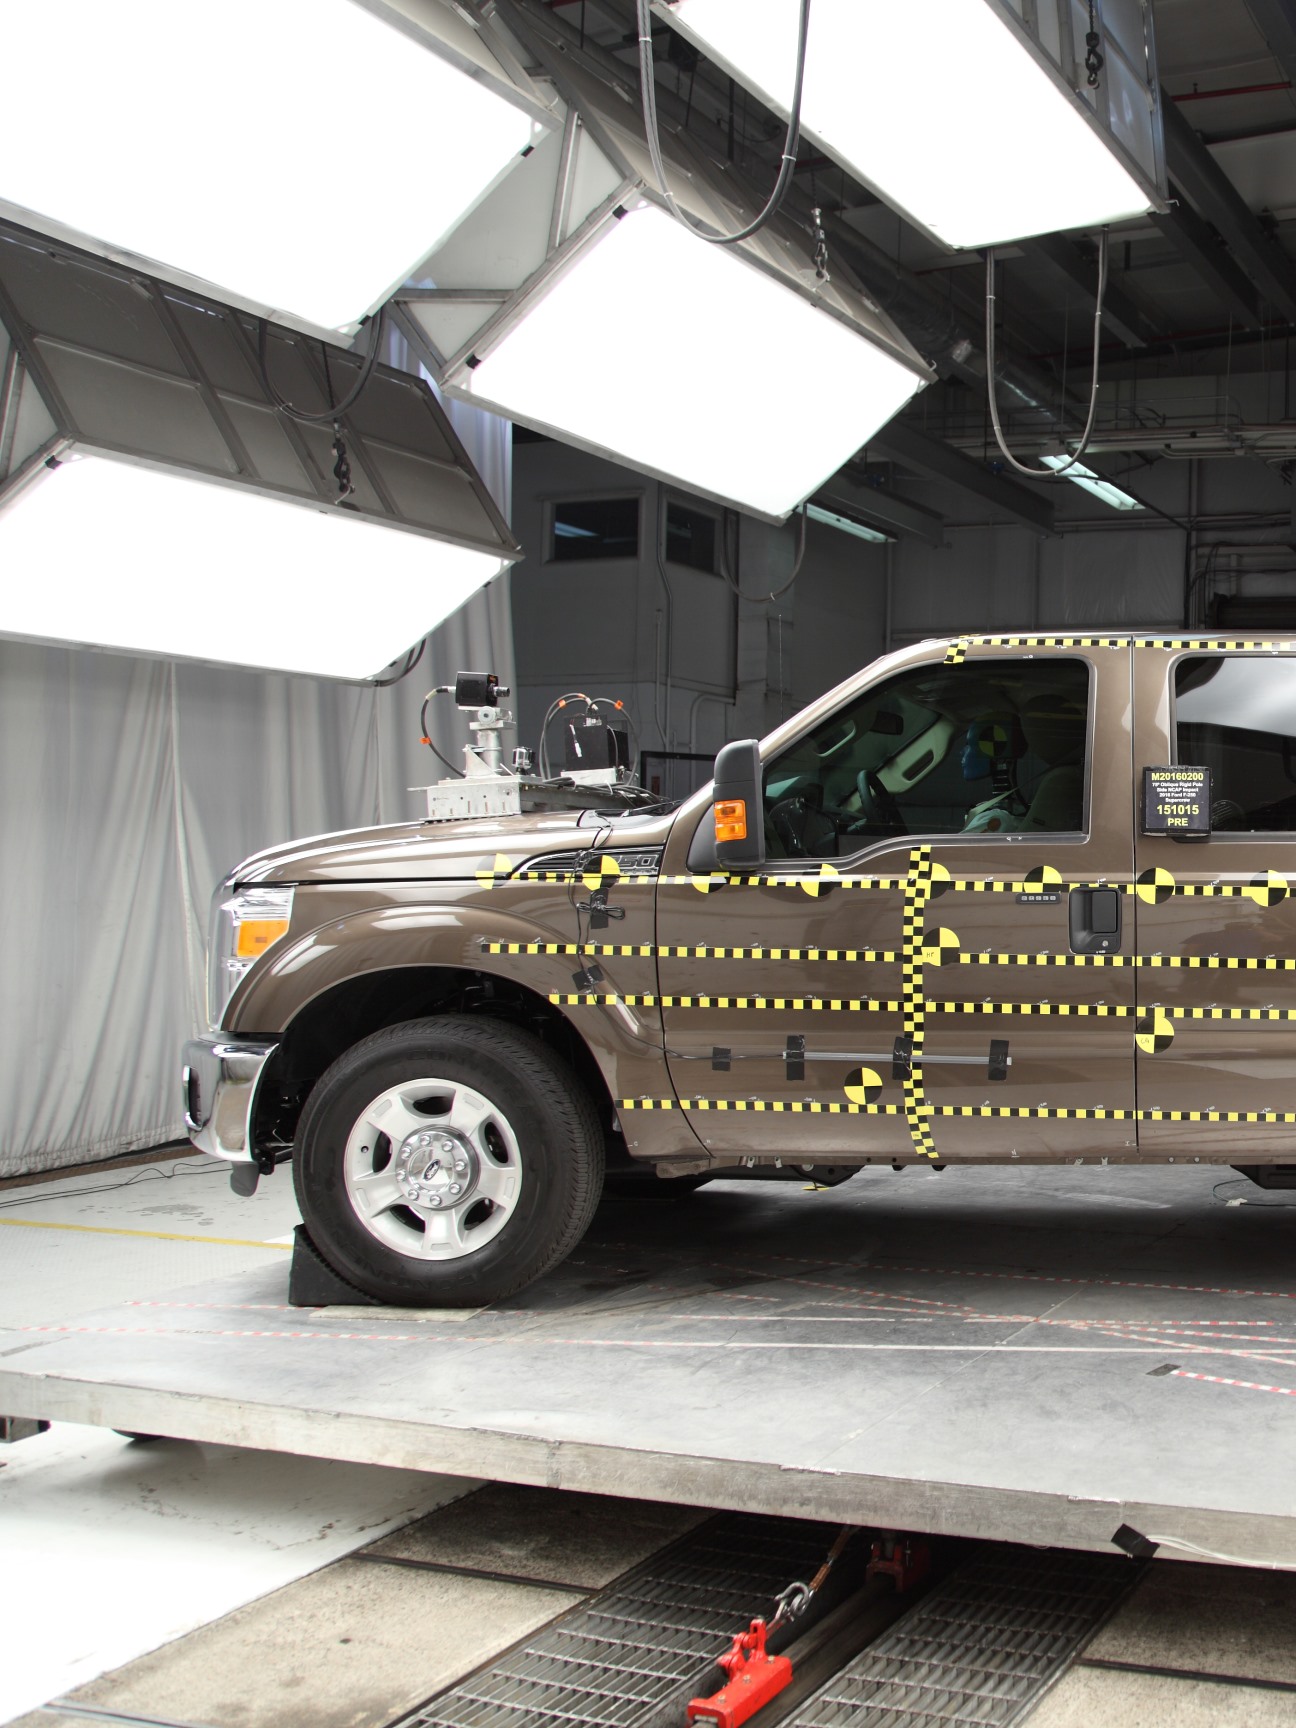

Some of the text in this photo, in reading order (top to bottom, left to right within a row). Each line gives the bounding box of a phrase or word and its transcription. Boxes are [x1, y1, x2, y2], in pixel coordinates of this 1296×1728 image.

[1151, 772, 1204, 781] M20160200
[1156, 804, 1199, 815] 151015
[1167, 818, 1189, 826] PRE
